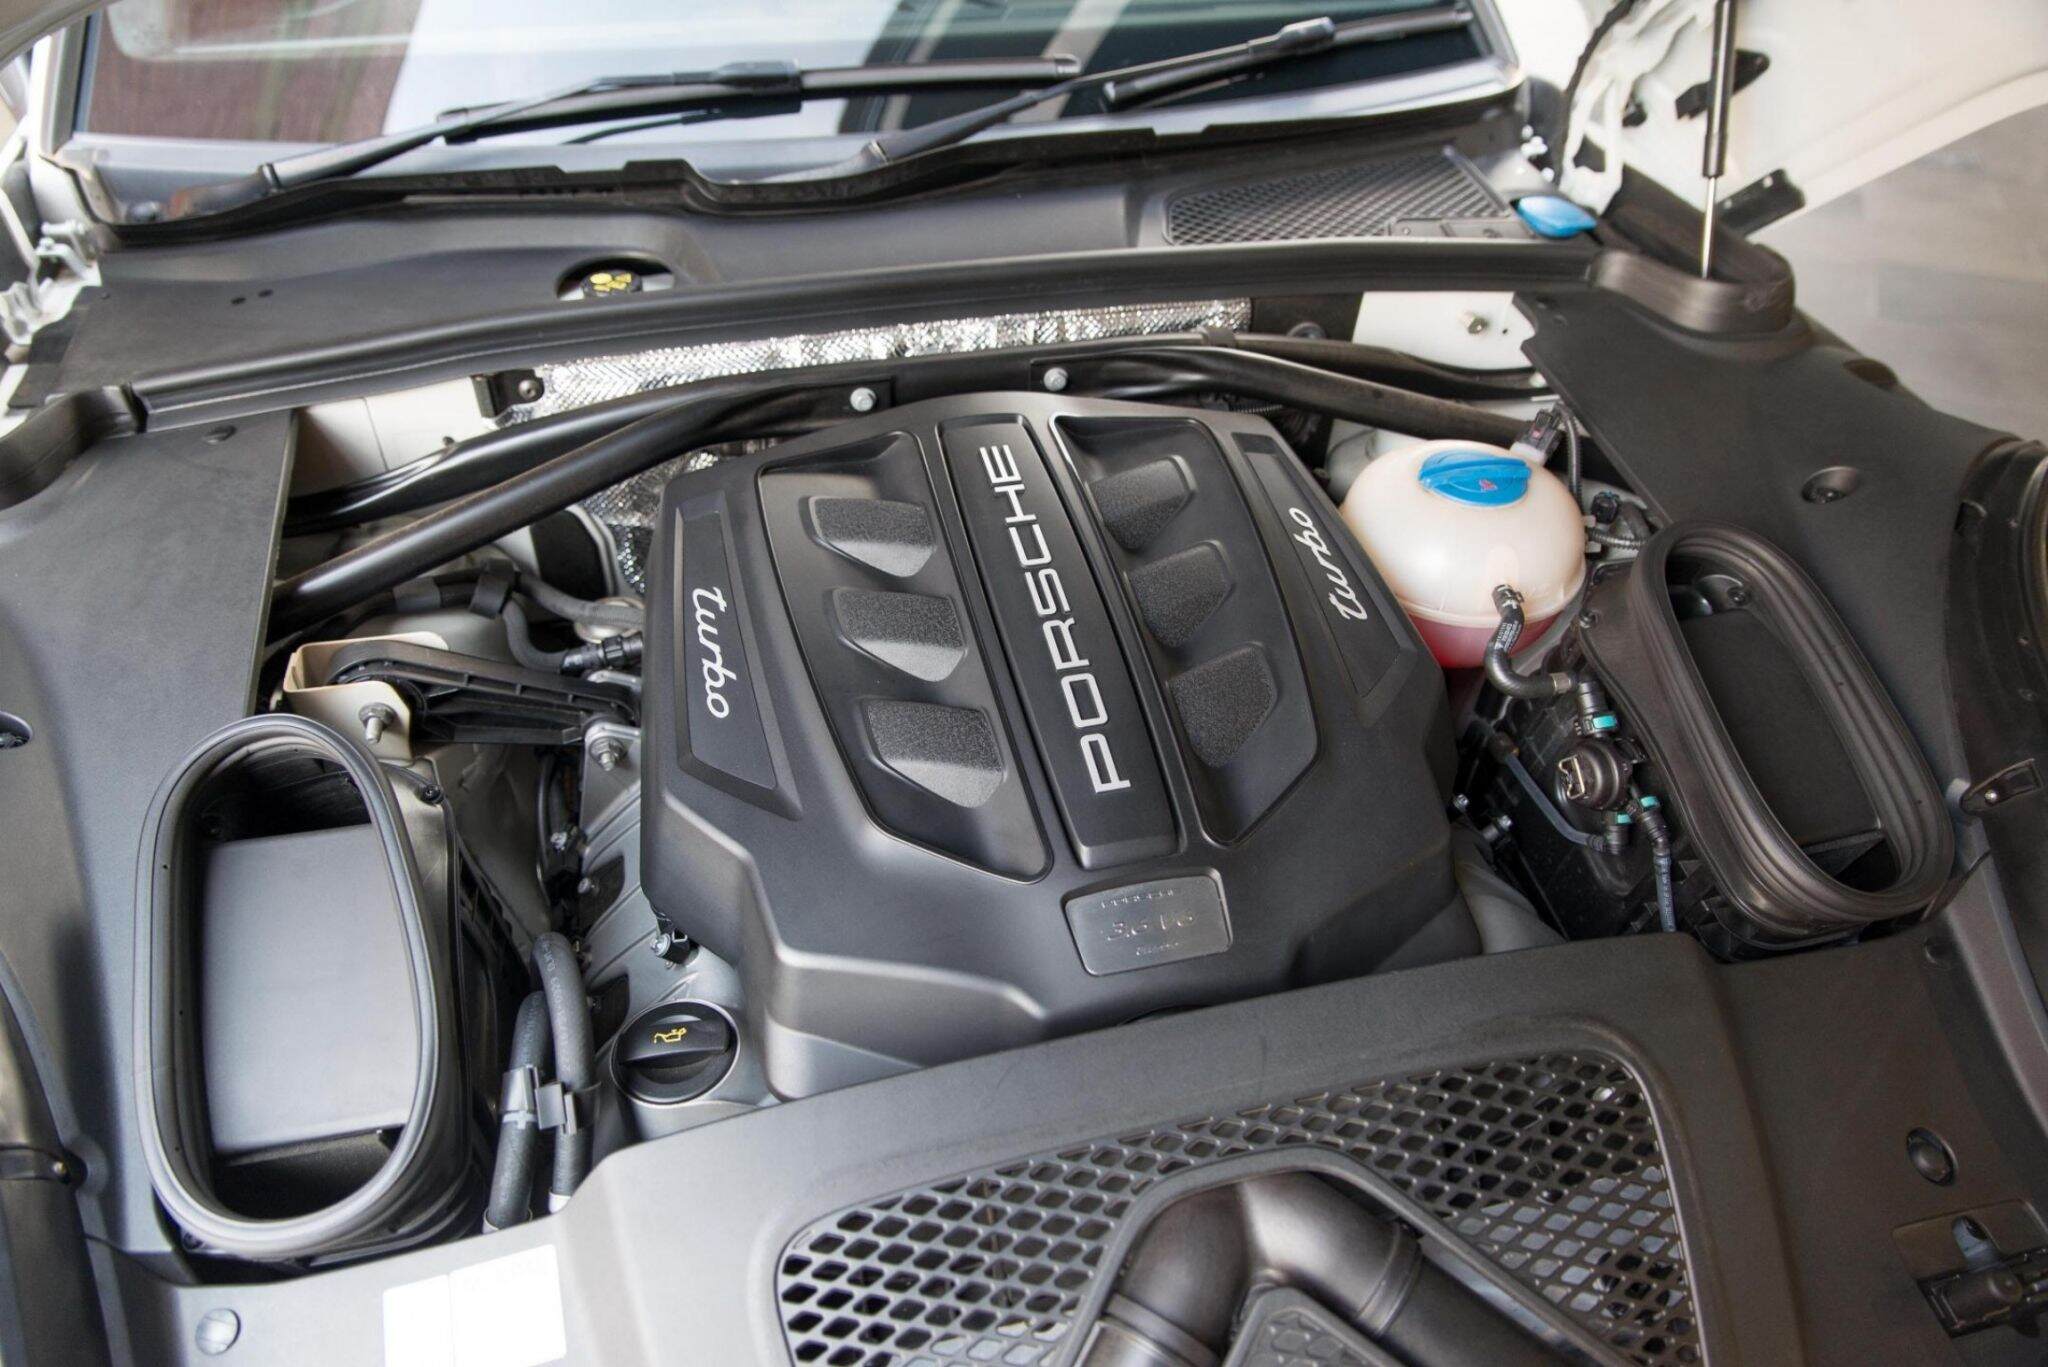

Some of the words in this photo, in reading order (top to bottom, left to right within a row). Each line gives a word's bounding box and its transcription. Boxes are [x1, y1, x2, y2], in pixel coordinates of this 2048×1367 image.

[979, 444, 1131, 794] PORSCHE
[1288, 507, 1368, 620] turbo
[692, 586, 737, 719] turbo
